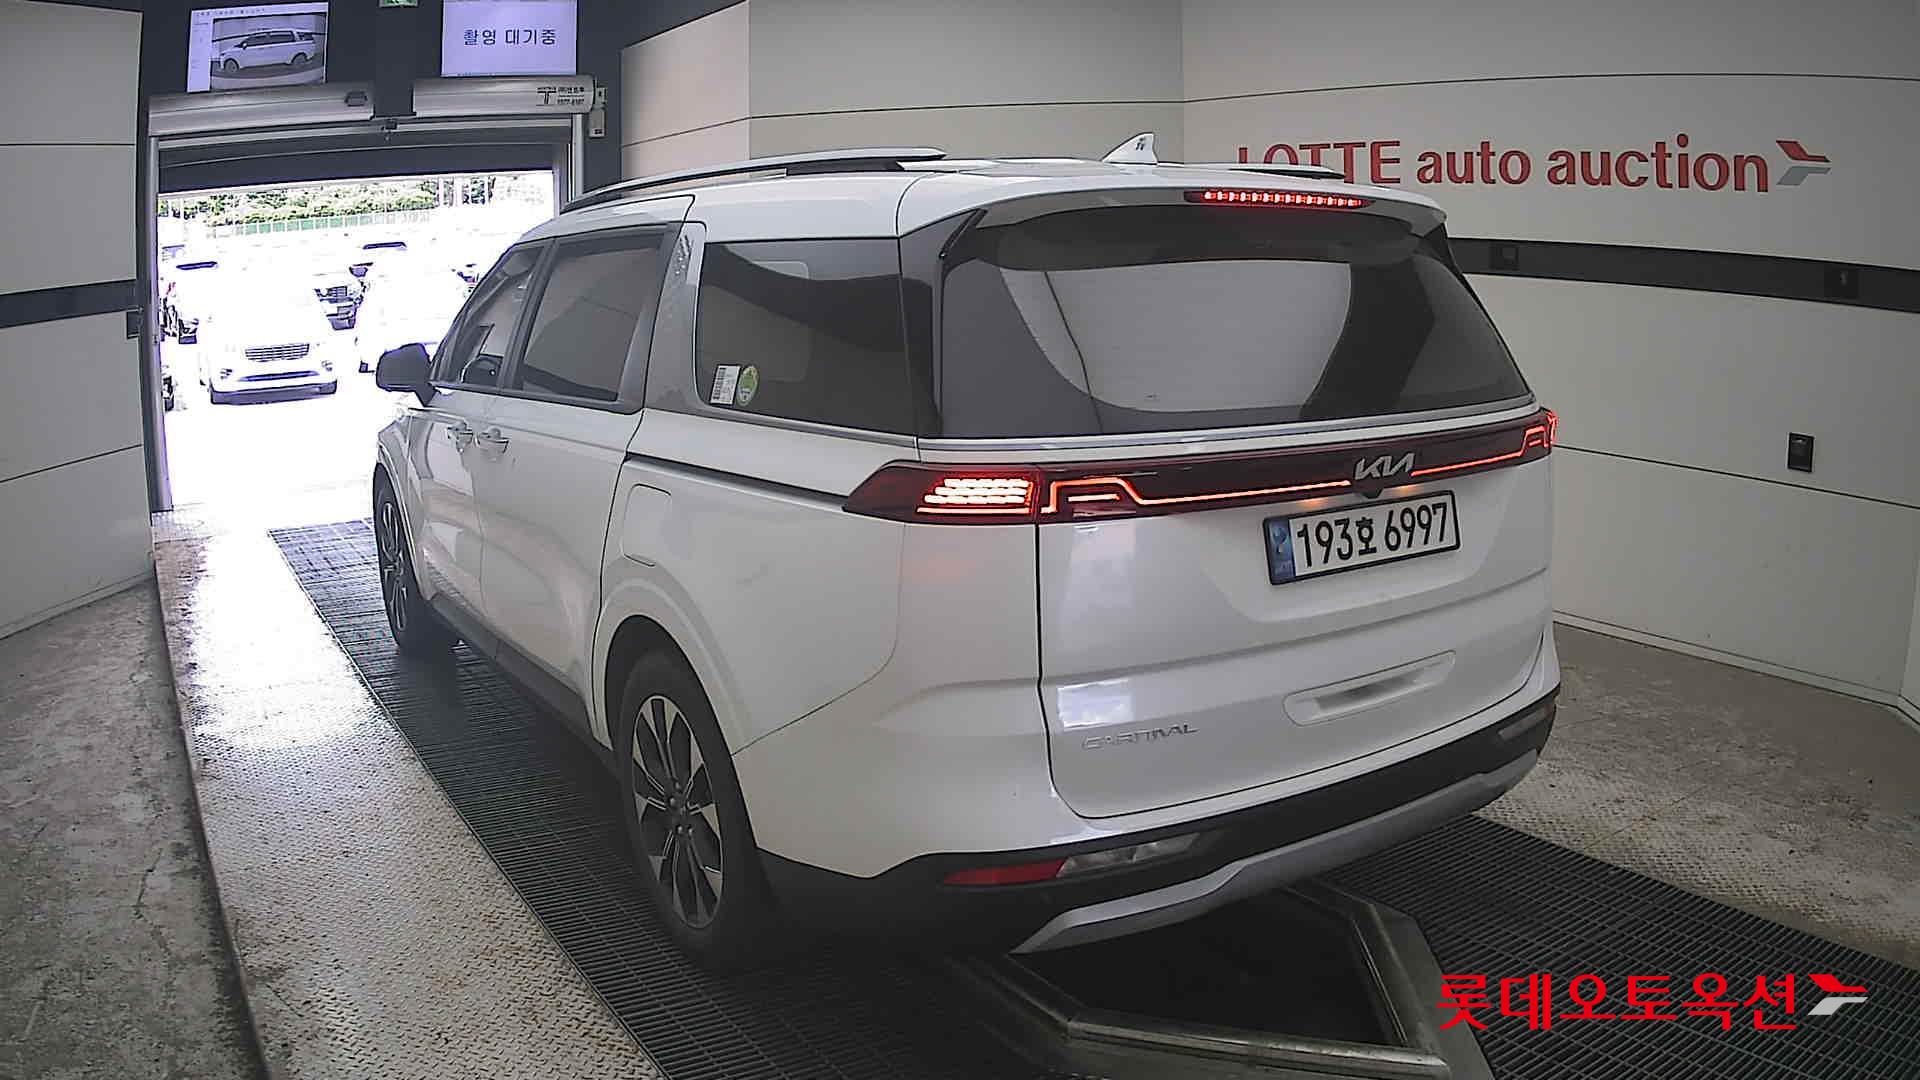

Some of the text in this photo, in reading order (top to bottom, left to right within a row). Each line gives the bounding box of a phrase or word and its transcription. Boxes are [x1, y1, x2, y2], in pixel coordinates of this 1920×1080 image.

[464, 29, 556, 46] 촬영 대기중
[1416, 140, 1531, 185] auto
[1547, 133, 1769, 193] auction
[1354, 452, 1415, 481] KIA
[1384, 502, 1448, 552] 6997
